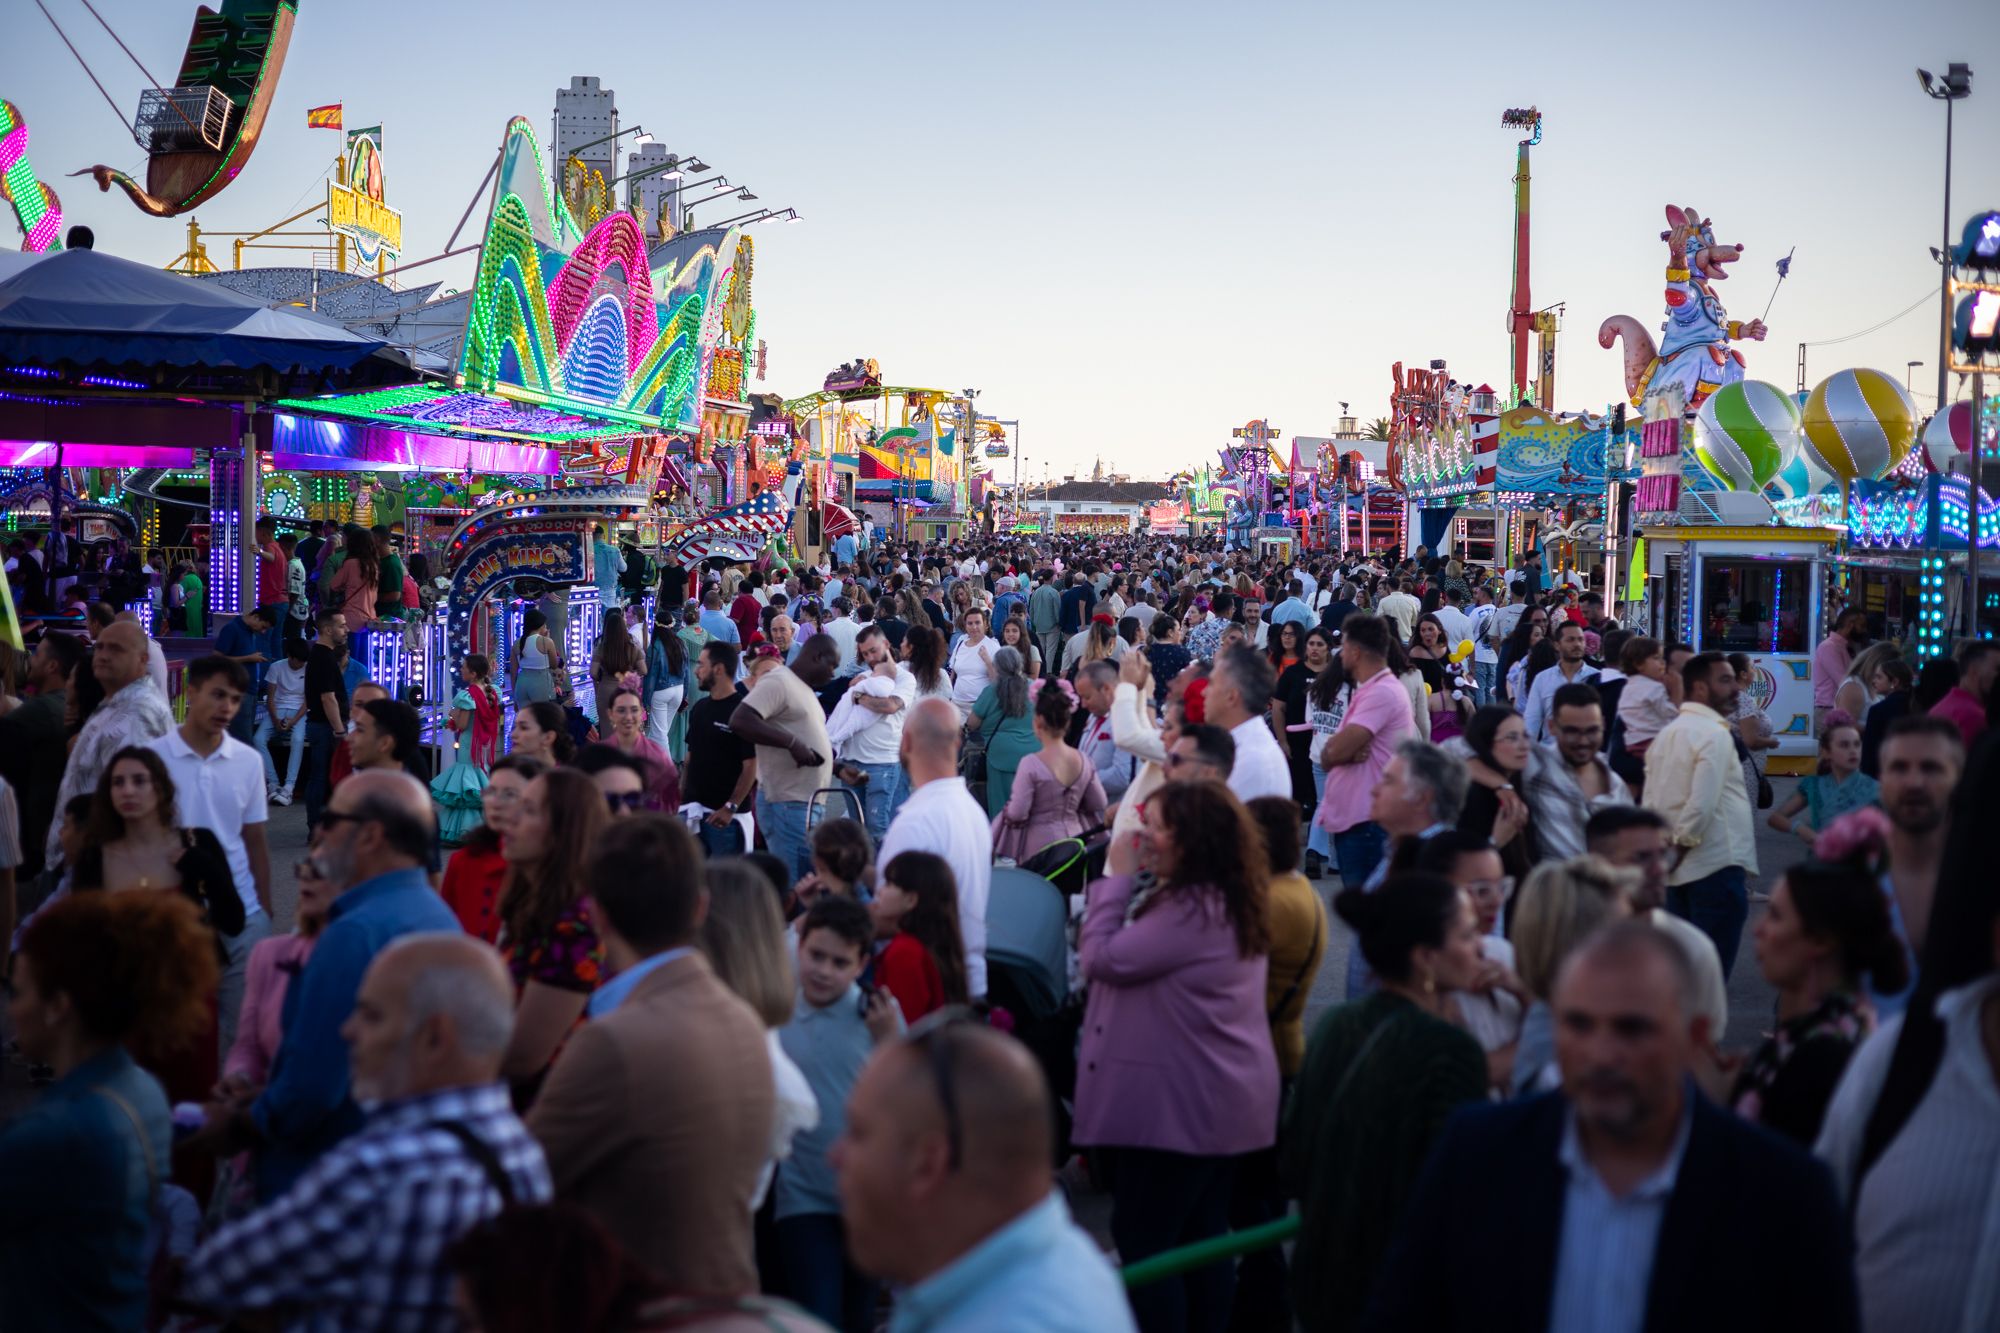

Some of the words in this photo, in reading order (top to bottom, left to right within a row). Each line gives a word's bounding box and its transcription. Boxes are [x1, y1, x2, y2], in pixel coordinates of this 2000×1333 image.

[1634, 475, 1673, 511] BALLOON
[731, 531, 759, 543] KING
[468, 552, 501, 585] THE
[508, 547, 555, 567] KING
